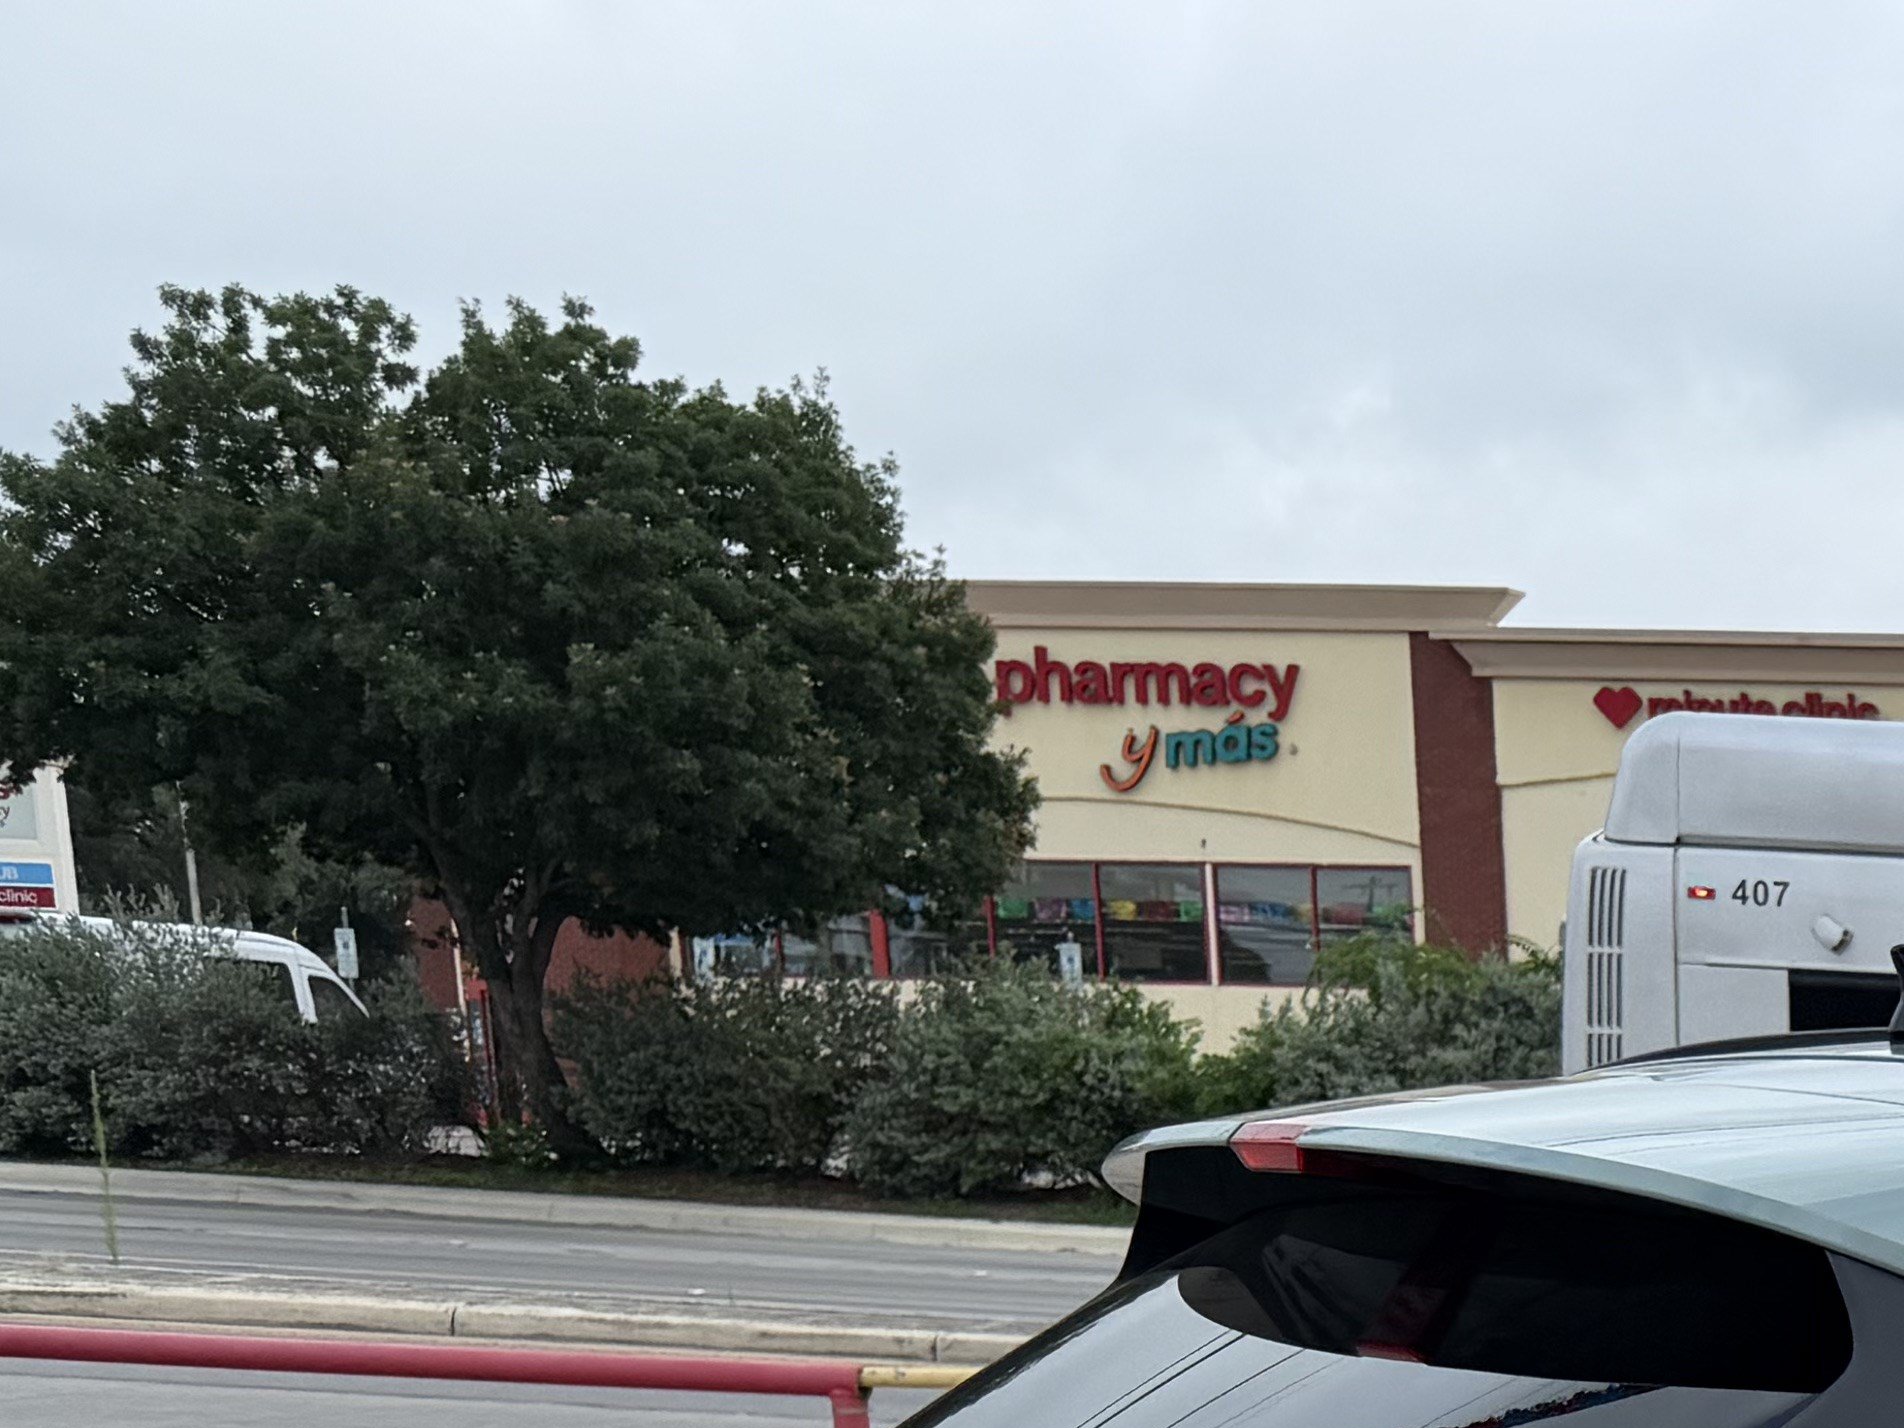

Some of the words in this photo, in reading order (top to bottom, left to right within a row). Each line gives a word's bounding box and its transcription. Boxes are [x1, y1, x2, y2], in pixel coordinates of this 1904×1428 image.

[995, 646, 1300, 722] pharmacy
[1100, 725, 1160, 792] y
[1165, 710, 1280, 769] más
[1732, 879, 1790, 907] 407
